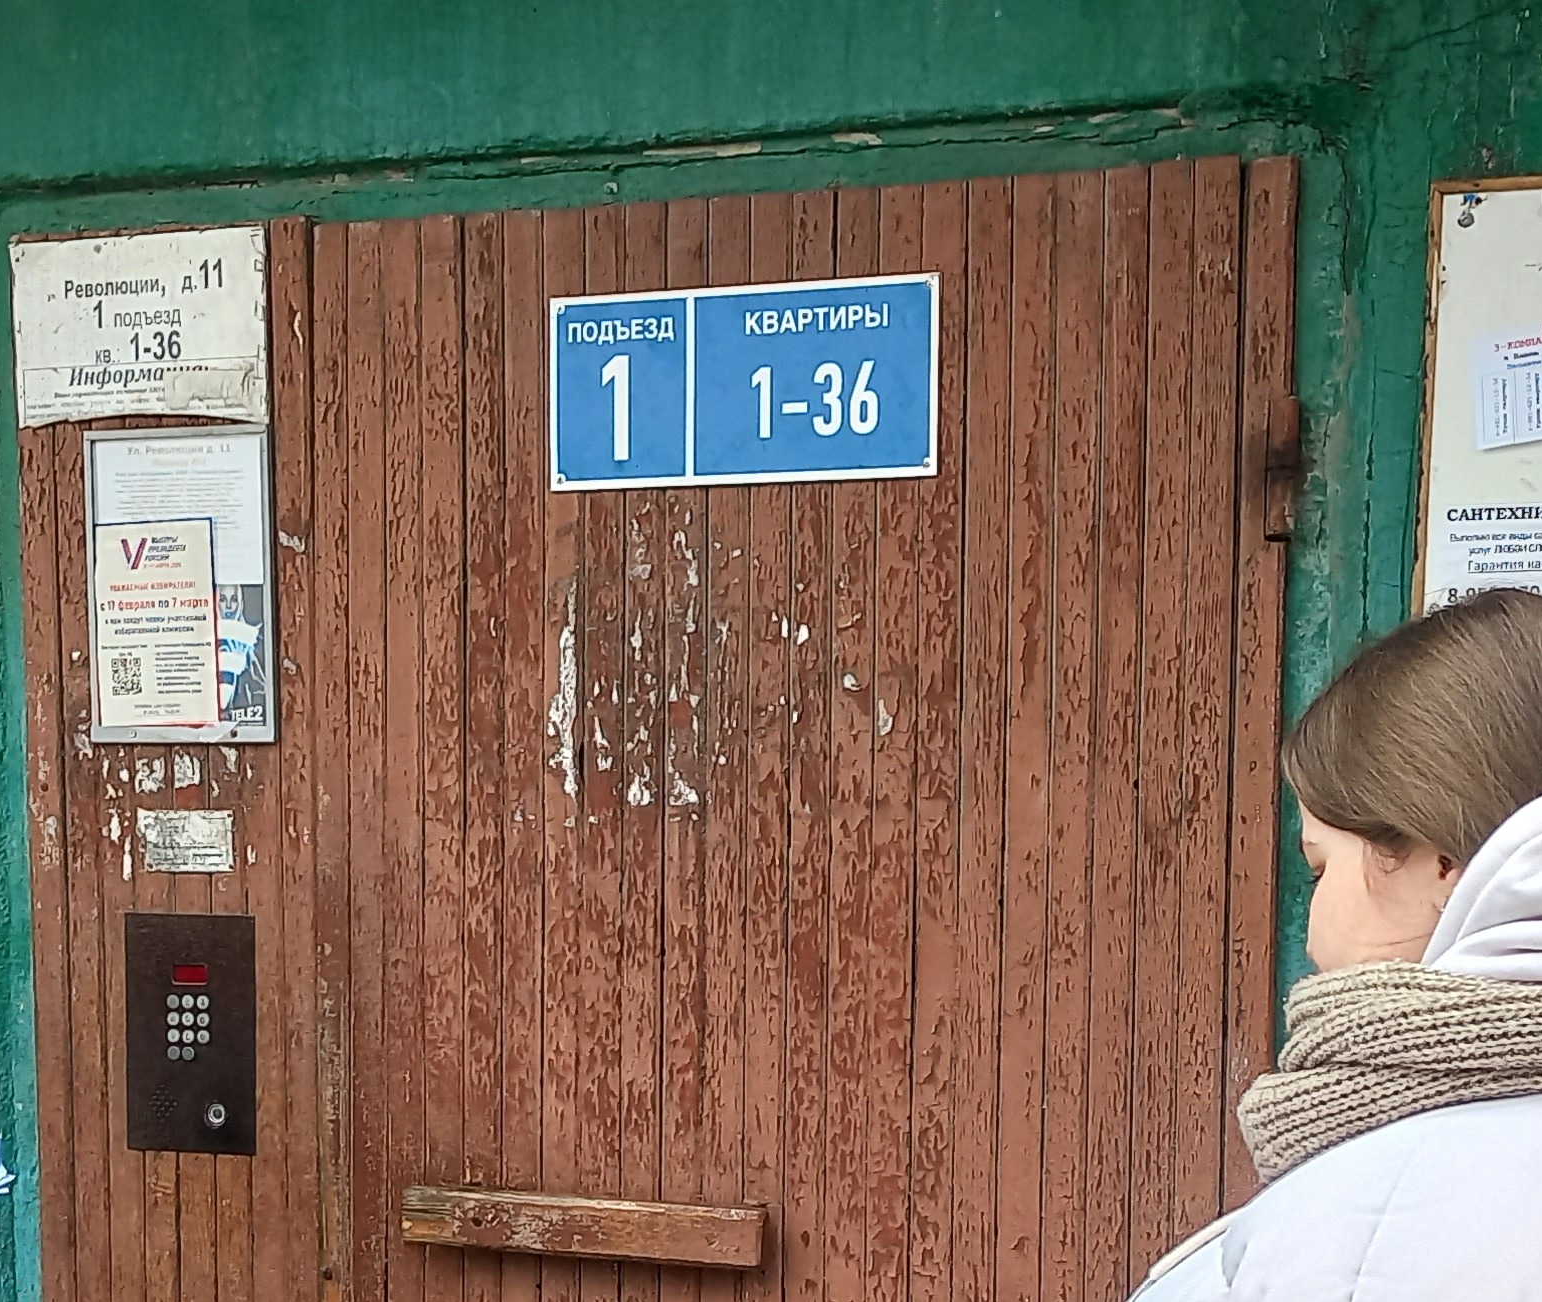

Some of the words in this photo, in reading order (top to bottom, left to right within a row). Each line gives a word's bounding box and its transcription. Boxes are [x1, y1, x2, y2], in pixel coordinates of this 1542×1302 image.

[63, 277, 166, 299] Революции,
[93, 300, 104, 329] 1
[113, 308, 182, 330] подъезд
[566, 316, 675, 346] ПОДЪЕЗД
[744, 303, 890, 336] КВАРТИРЫ
[129, 331, 182, 362] 1-36
[601, 354, 632, 462] 1
[750, 360, 880, 440] 1-36
[219, 443, 231, 453] 11
[1467, 560, 1524, 572] Гарантия
[118, 600, 156, 611] февраля
[158, 600, 170, 609] по
[171, 597, 177, 607] 7
[179, 599, 209, 609] марта
[230, 705, 264, 721] TELE2
